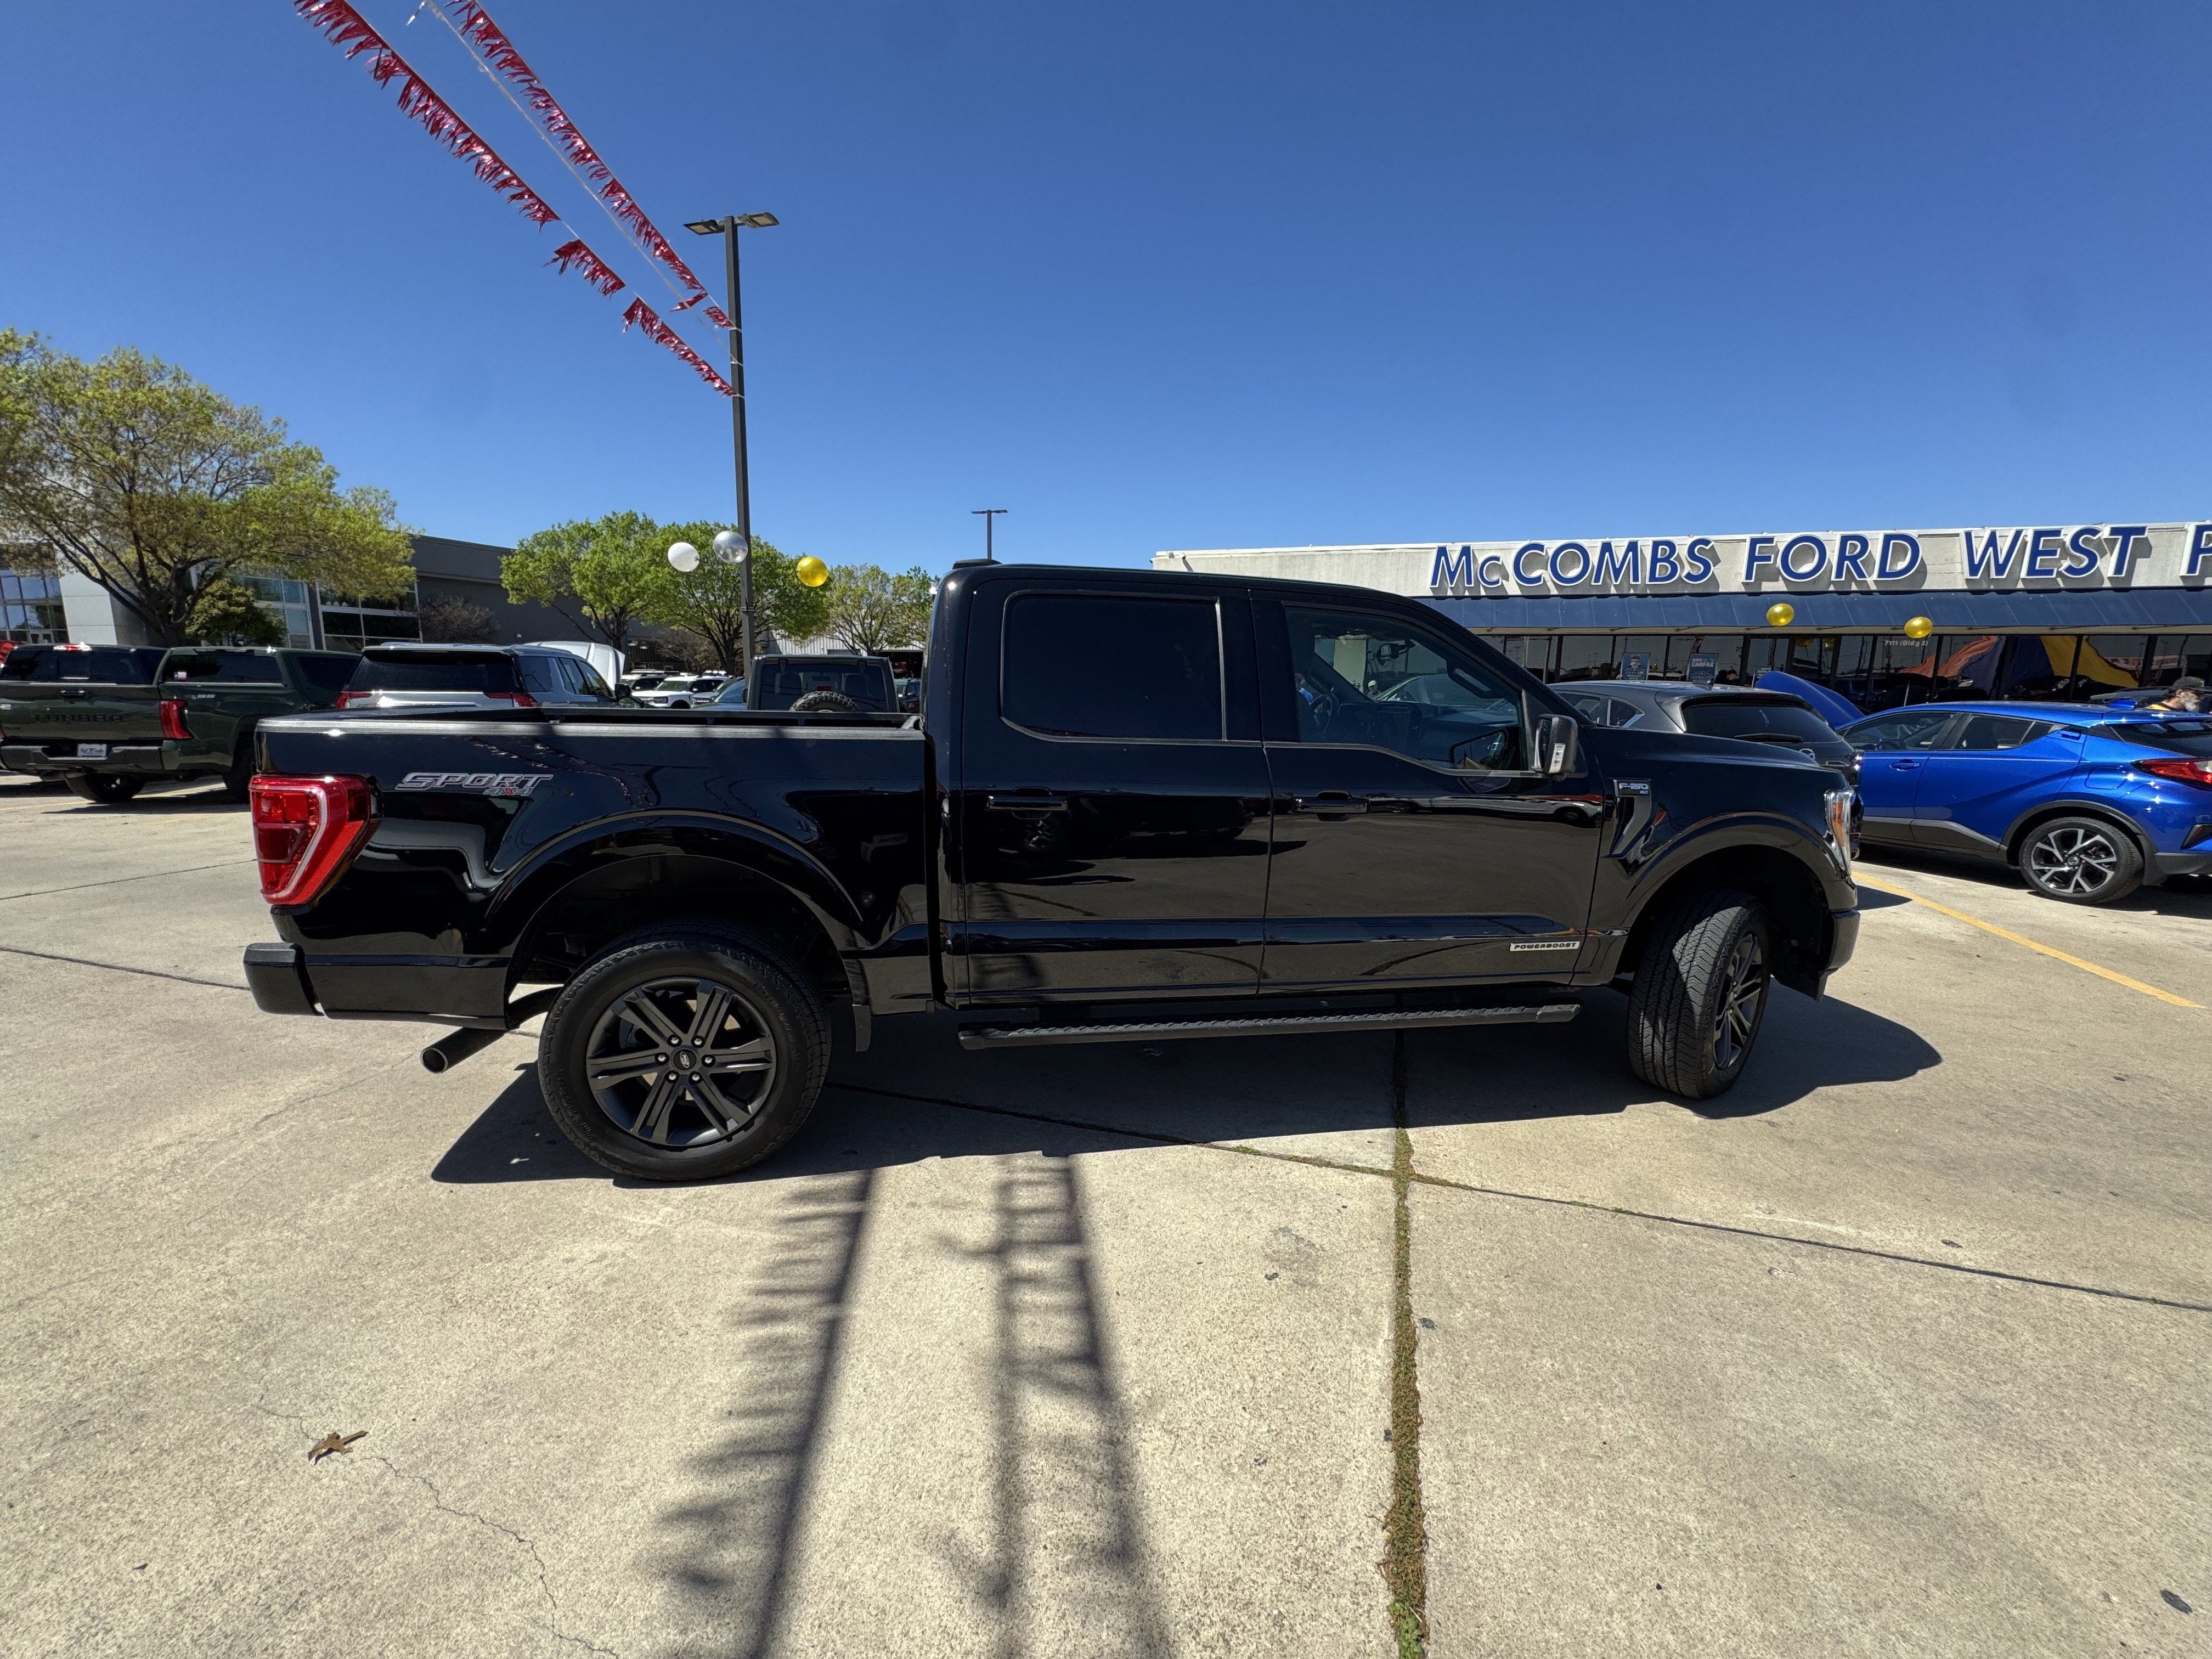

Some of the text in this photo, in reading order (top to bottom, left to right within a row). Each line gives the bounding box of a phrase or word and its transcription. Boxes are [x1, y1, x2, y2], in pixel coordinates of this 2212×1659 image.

[1741, 533, 1922, 583] FORD
[1960, 525, 2148, 579] WEST
[33, 713, 123, 722] TUNDRA
[395, 772, 554, 791] SPORT
